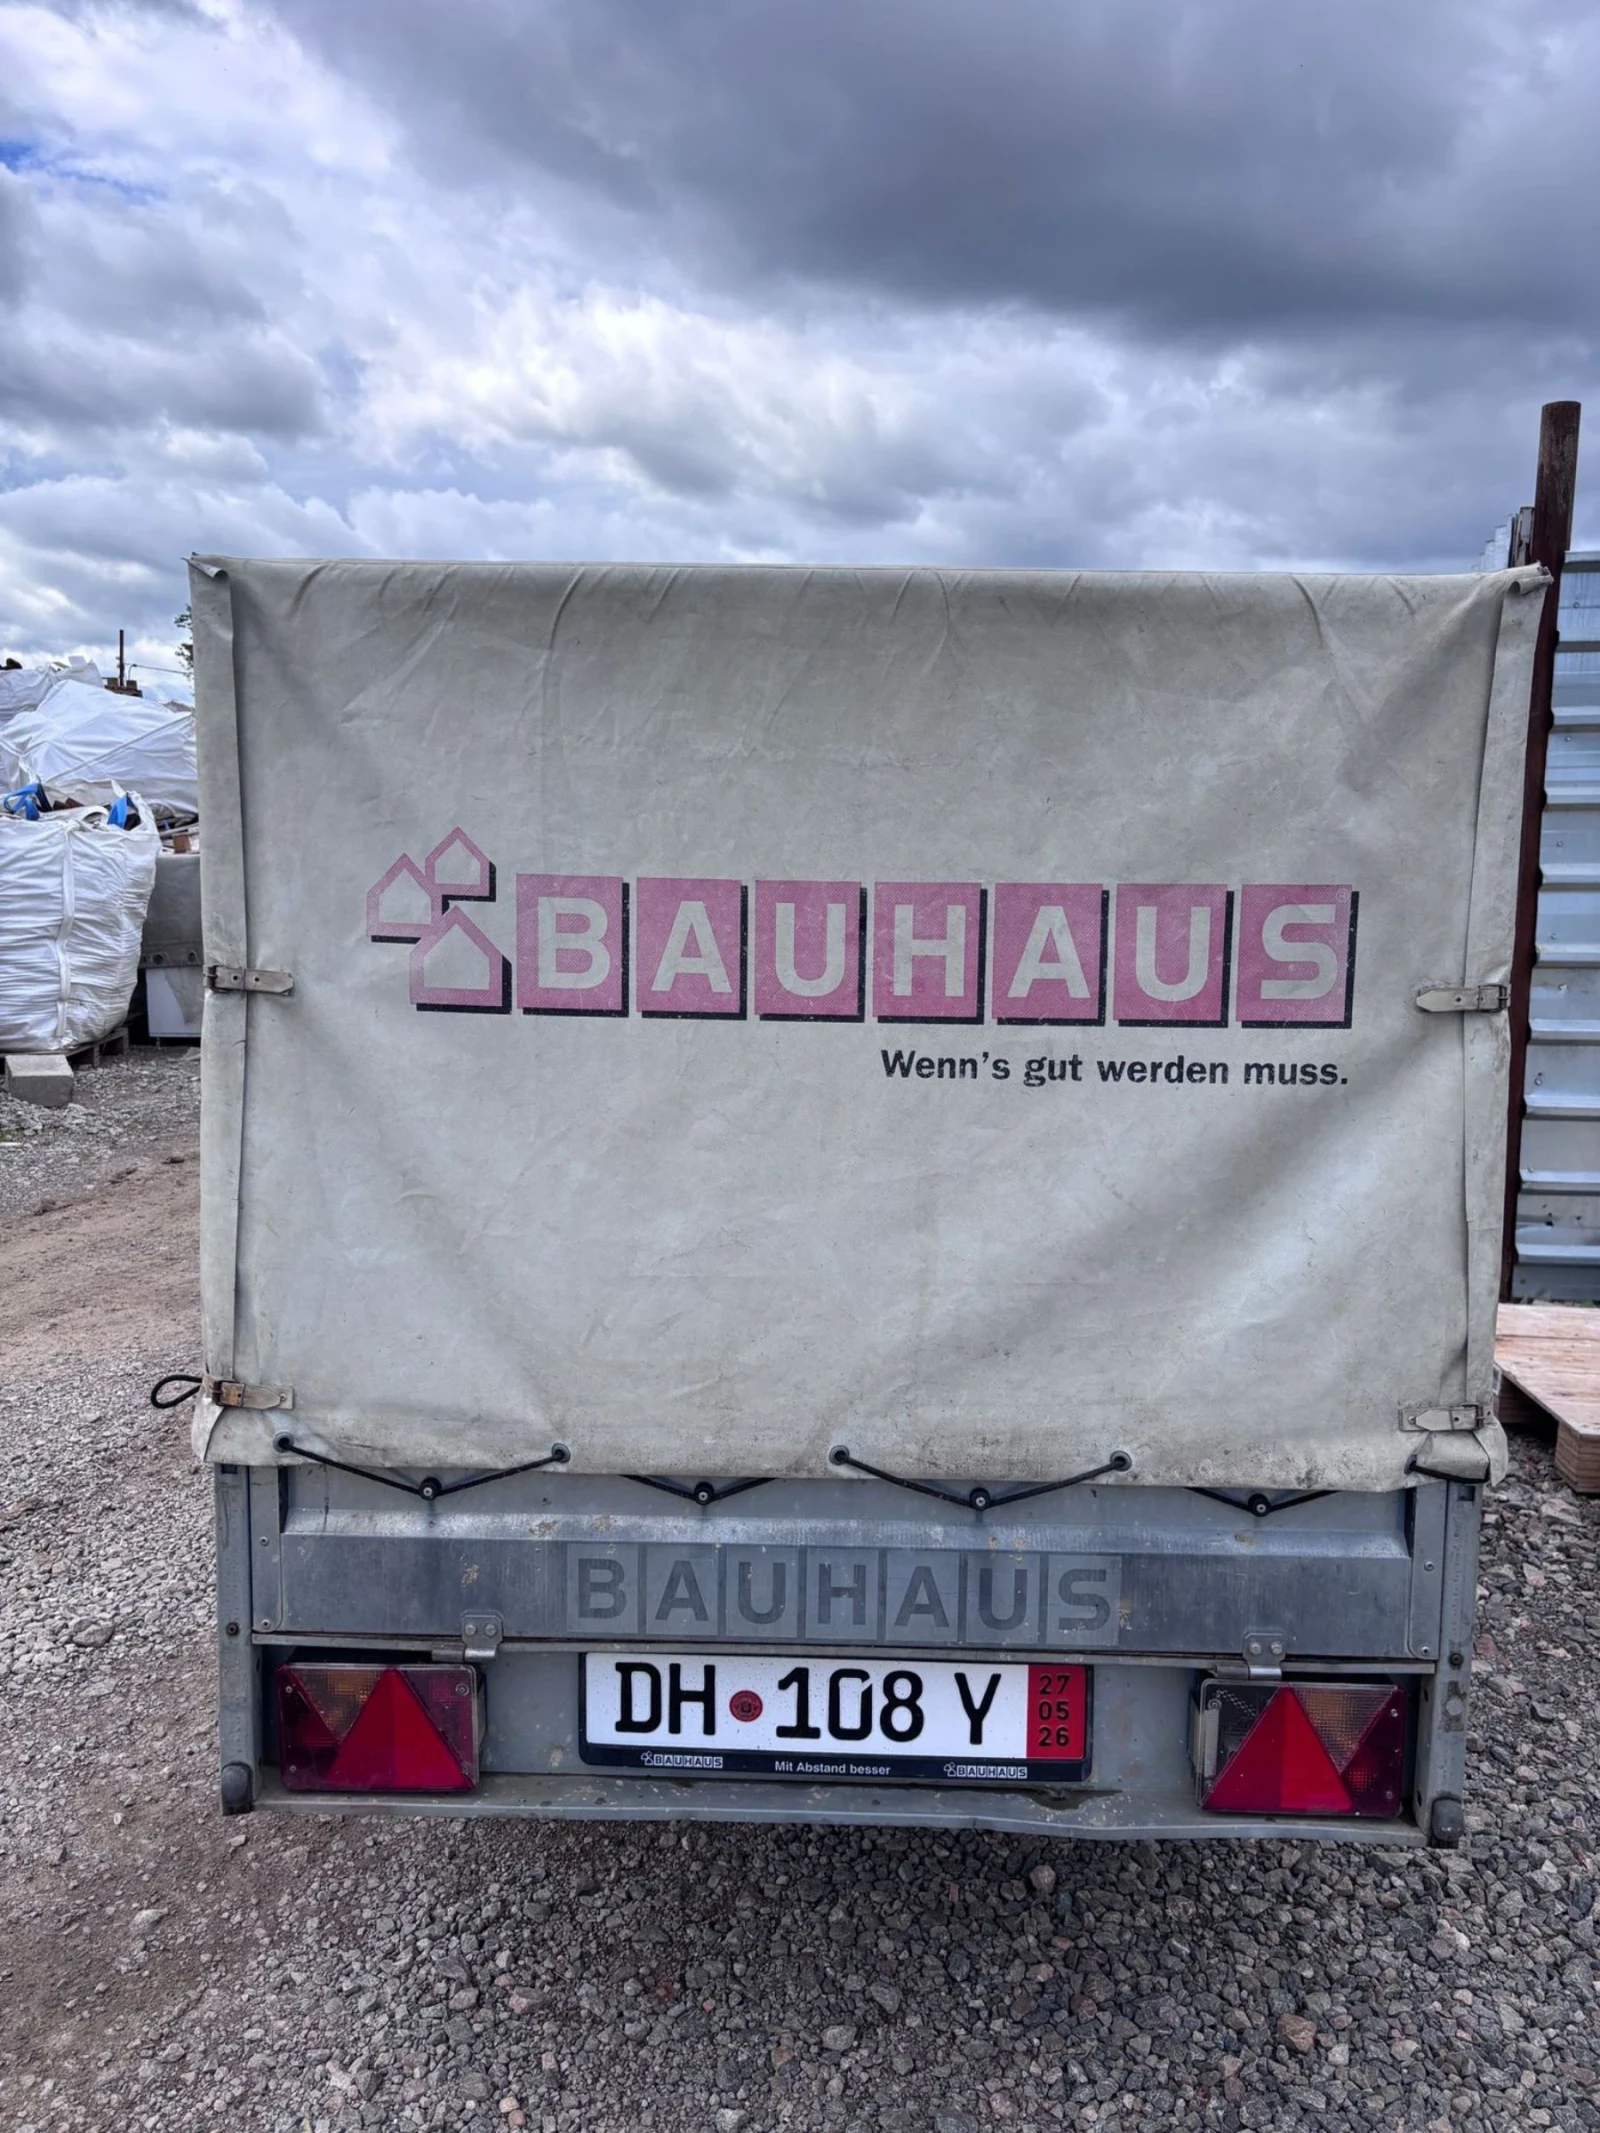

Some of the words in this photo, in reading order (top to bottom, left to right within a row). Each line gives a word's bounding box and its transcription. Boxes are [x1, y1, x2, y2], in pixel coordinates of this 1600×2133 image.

[535, 893, 1339, 1002] BAUHAUS
[880, 1049, 1010, 1080] Wenn's
[1023, 1055, 1083, 1087] gut
[1097, 1055, 1229, 1084] werden
[1243, 1058, 1349, 1086] muss.
[576, 1556, 1111, 1632] BAUHAUS
[1039, 1675, 1071, 1695] 27
[614, 1662, 716, 1735] DH
[775, 1666, 924, 1743] 108
[953, 1672, 1002, 1745] Y
[1038, 1701, 1070, 1721] 05
[1038, 1726, 1070, 1747] 26
[653, 1754, 724, 1769] BAUHAUS
[774, 1760, 793, 1772] Mit
[796, 1762, 846, 1774] Abstand
[849, 1764, 891, 1775] besser
[956, 1765, 1028, 1779] BAUHAUS
